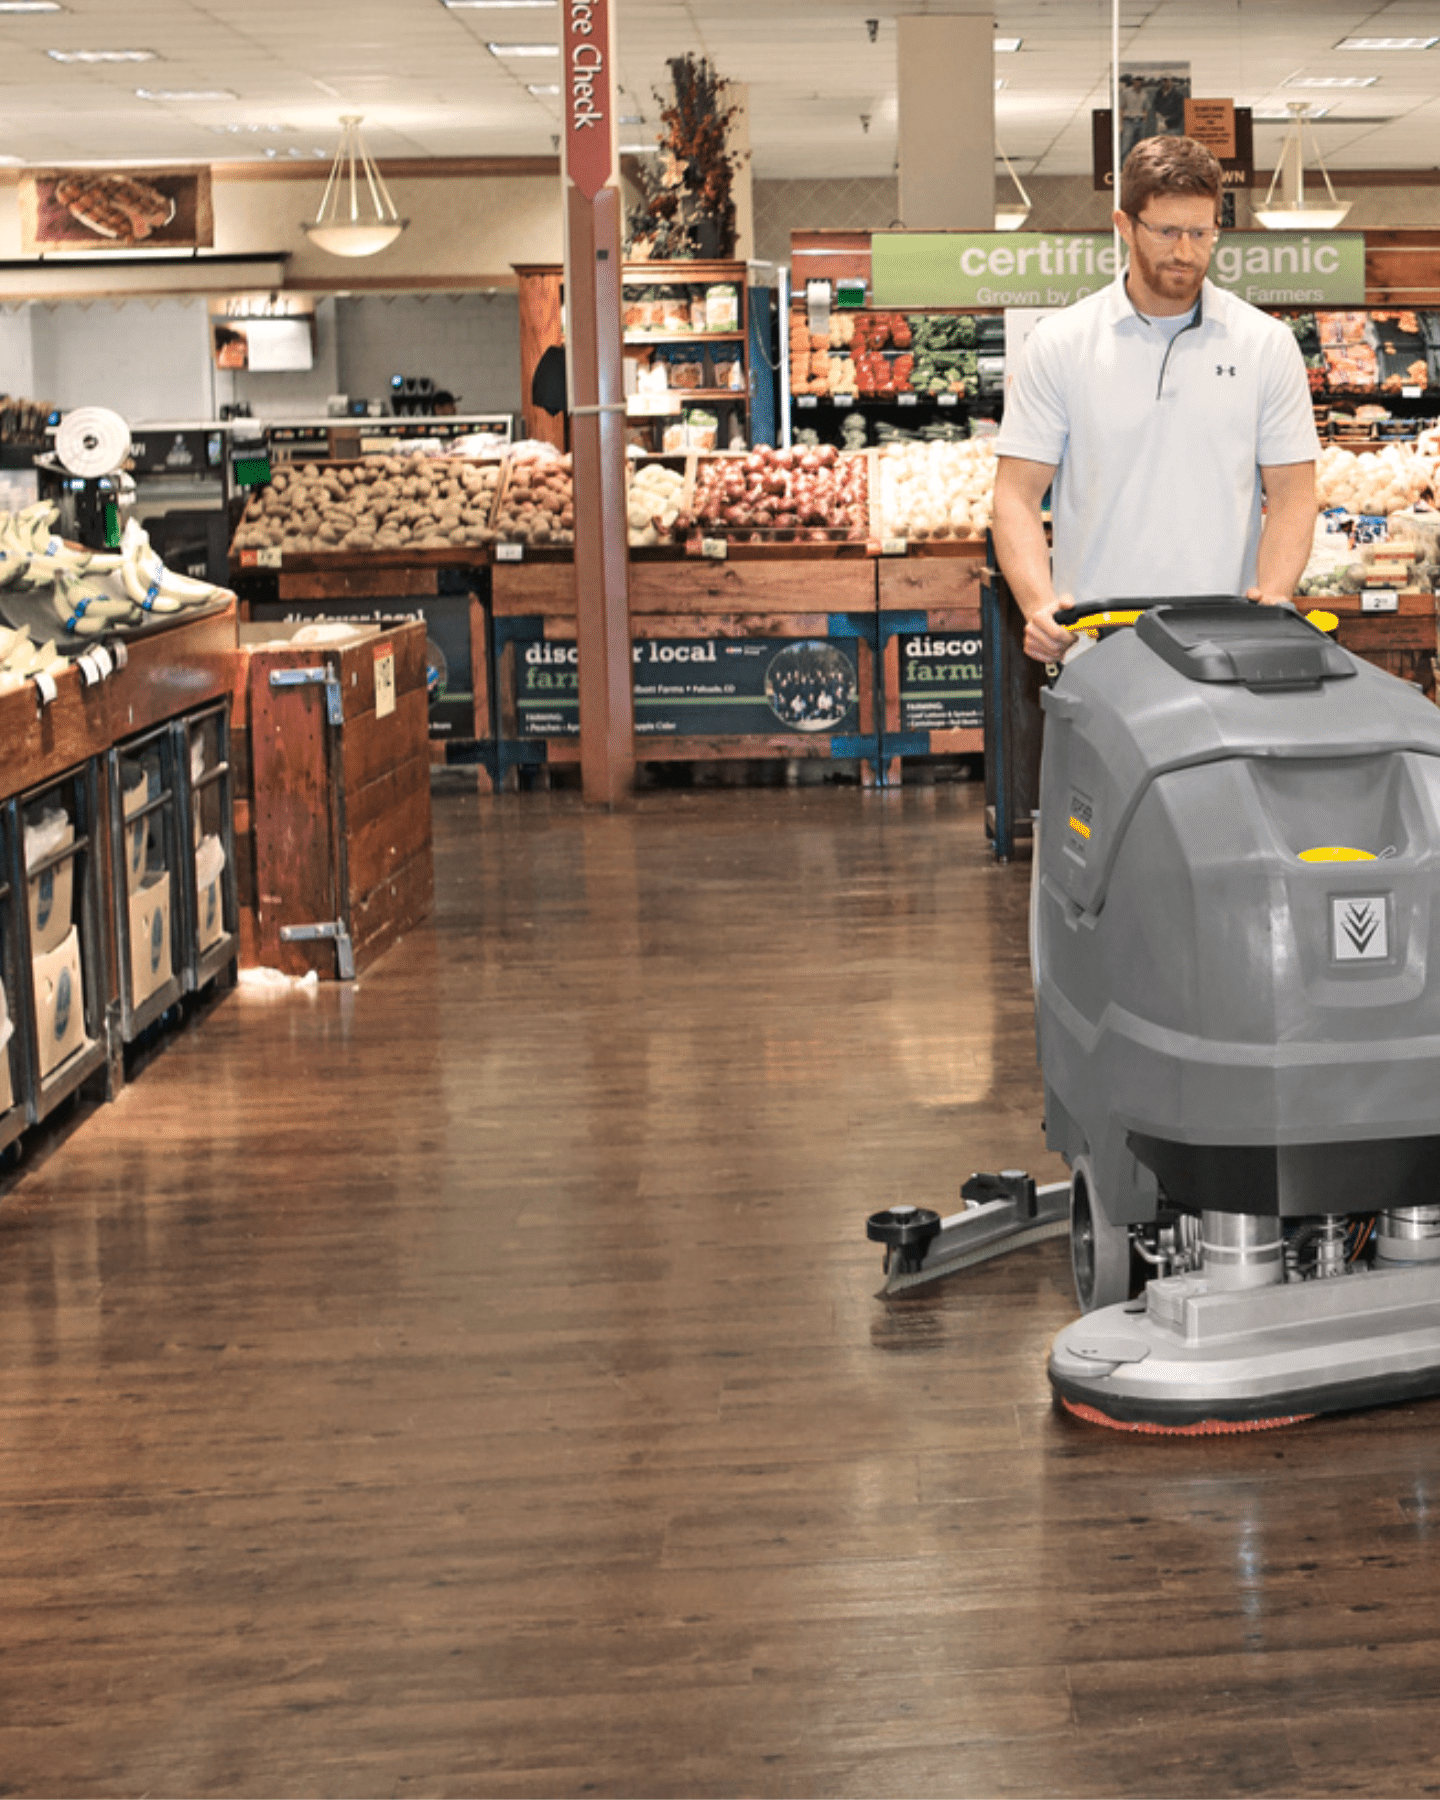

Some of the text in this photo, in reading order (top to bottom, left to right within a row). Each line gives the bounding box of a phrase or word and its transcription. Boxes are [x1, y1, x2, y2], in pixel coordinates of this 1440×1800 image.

[572, 43, 603, 131] Check
[960, 236, 1340, 284] certifie ganic
[976, 286, 1040, 305] Grown
[1046, 287, 1071, 307] by
[1245, 285, 1325, 302] Farmers
[525, 641, 644, 664] discr
[649, 641, 717, 663] local
